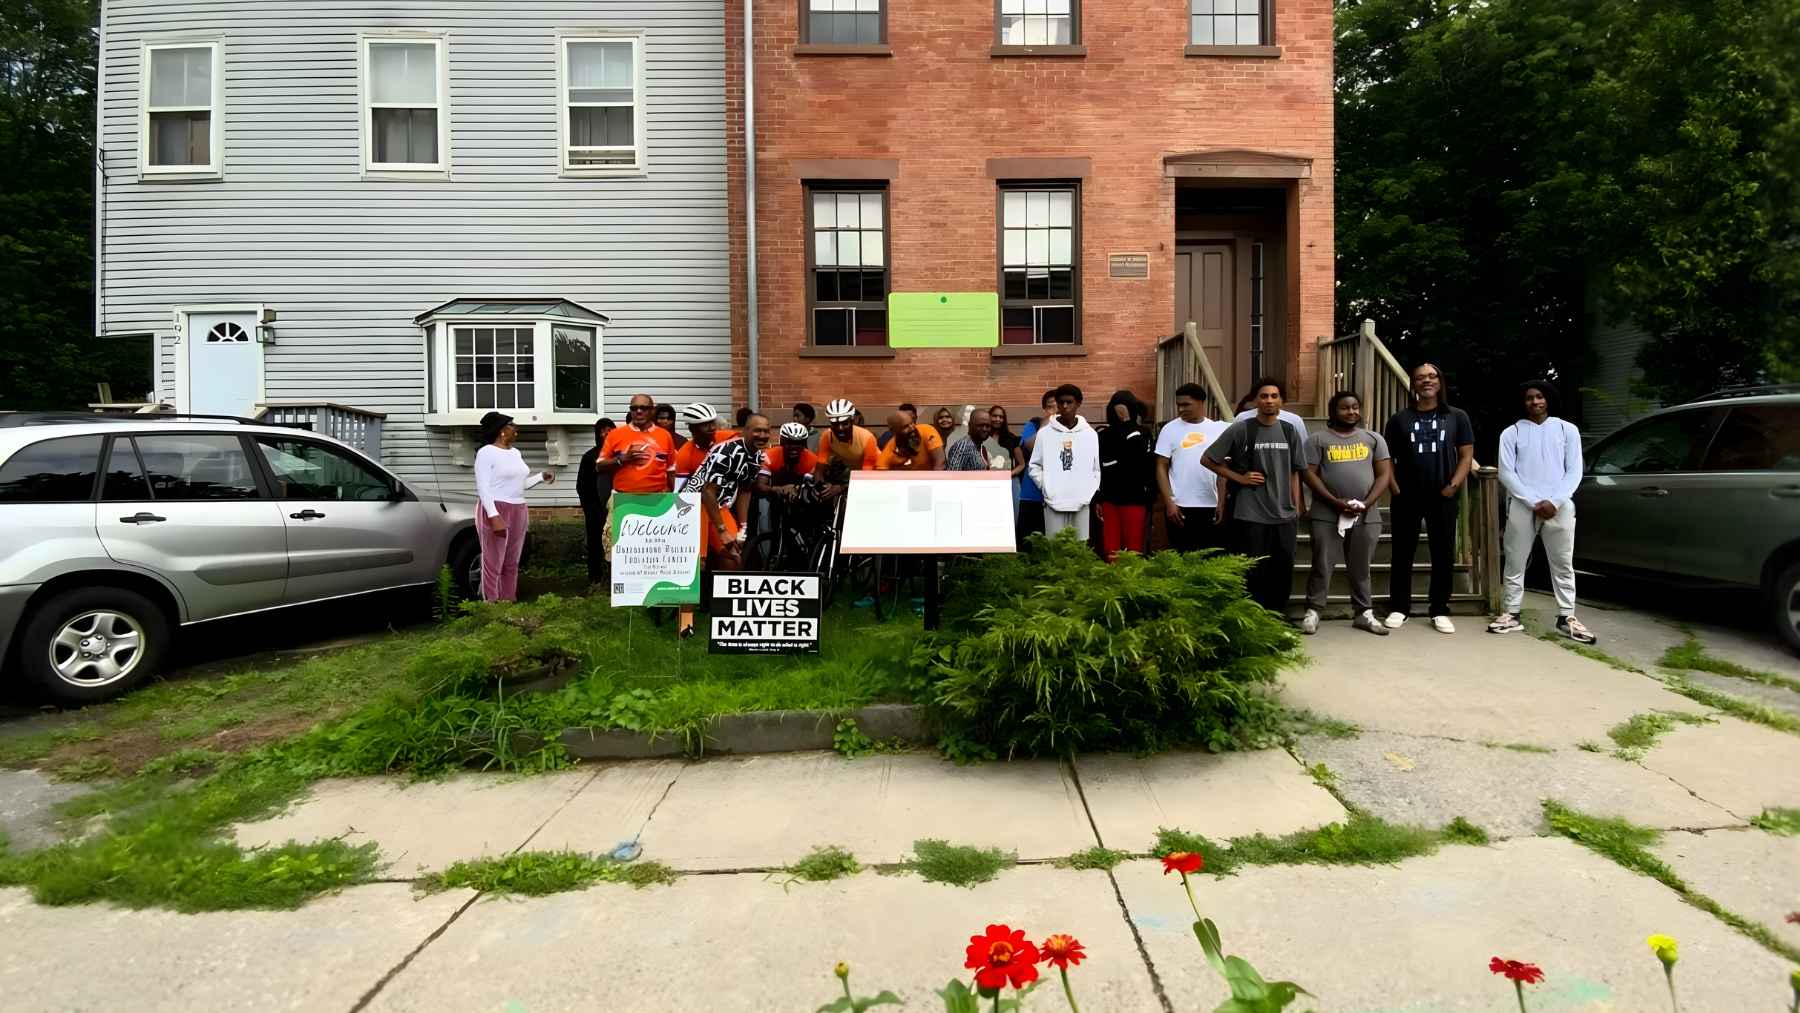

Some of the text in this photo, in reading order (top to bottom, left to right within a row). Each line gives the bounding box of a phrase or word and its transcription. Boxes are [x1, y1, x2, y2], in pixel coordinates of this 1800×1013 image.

[174, 313, 182, 345] 192
[621, 519, 689, 536] Welcome
[728, 578, 805, 596] BLACK
[732, 599, 800, 617] LIVES
[718, 620, 812, 637] MATTER
